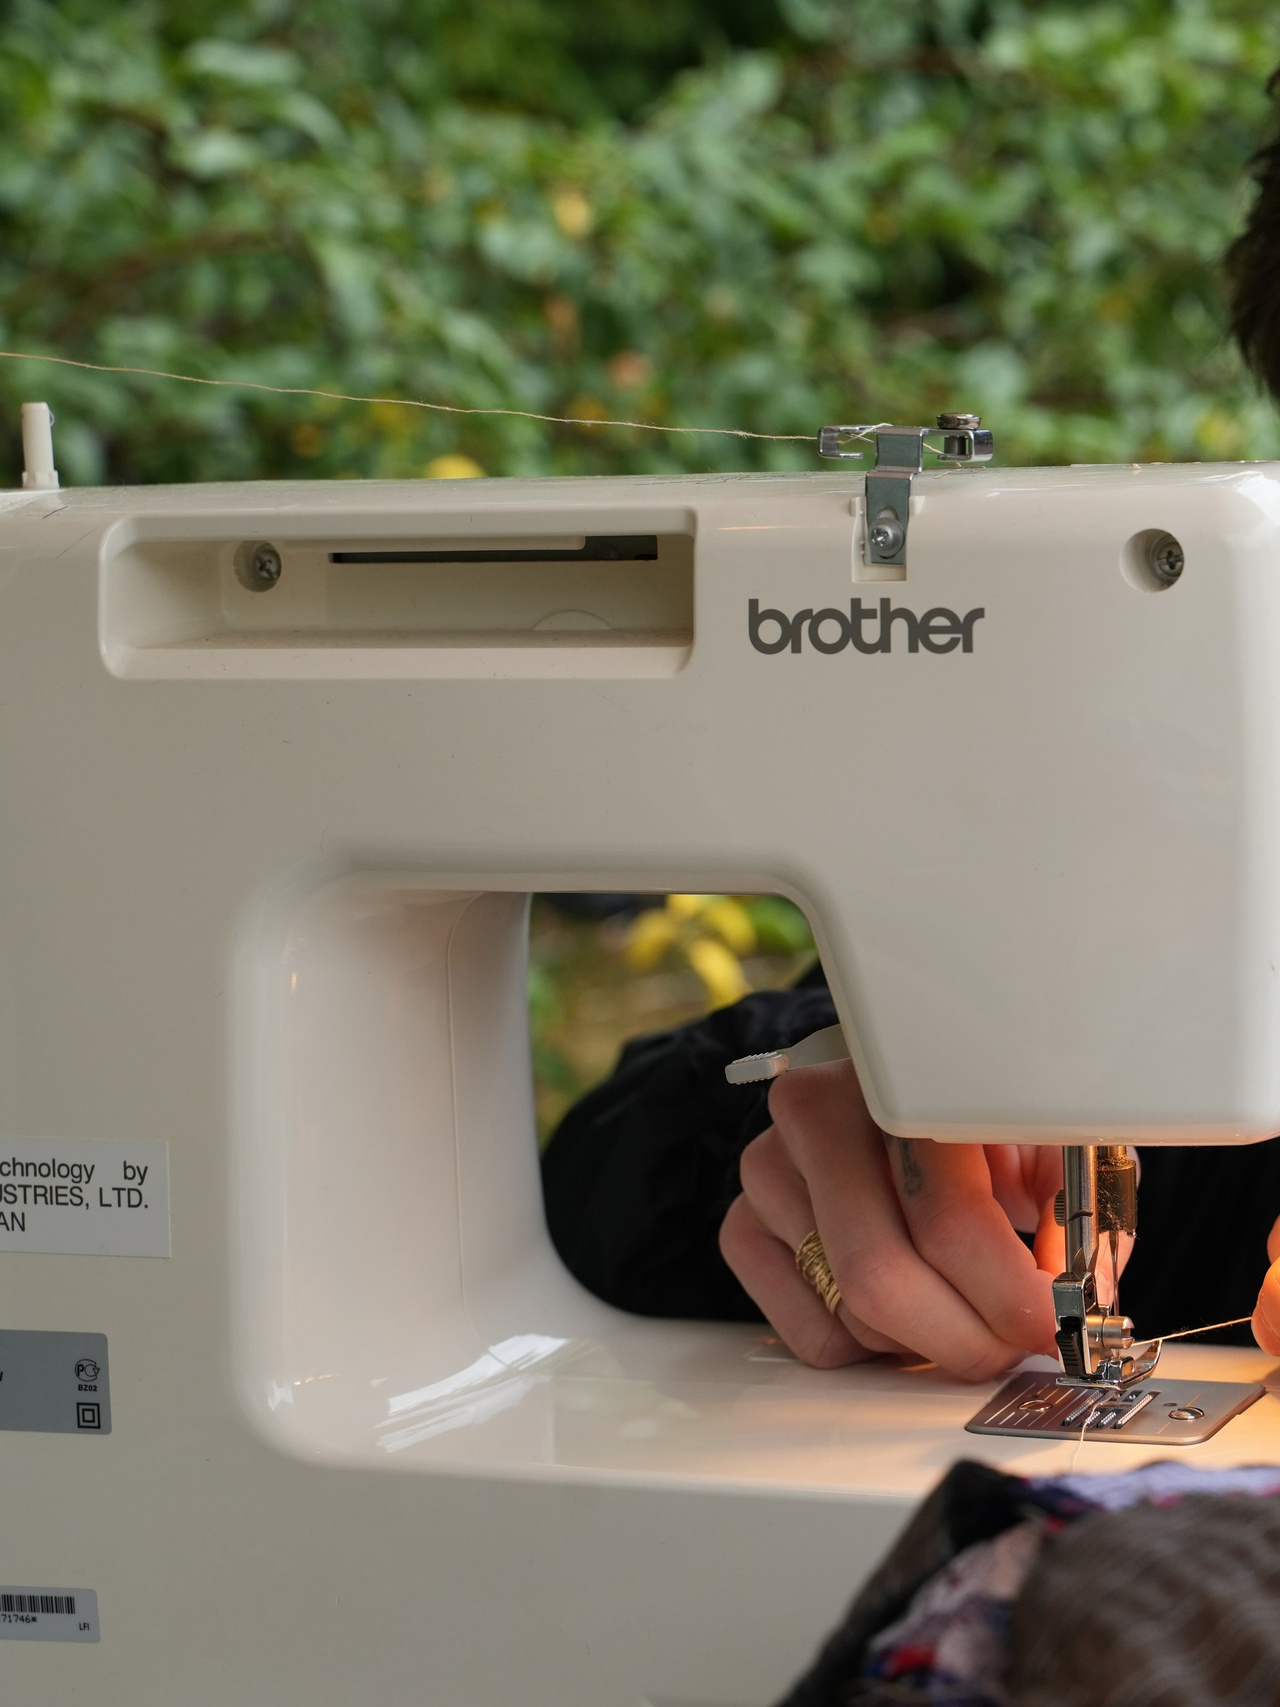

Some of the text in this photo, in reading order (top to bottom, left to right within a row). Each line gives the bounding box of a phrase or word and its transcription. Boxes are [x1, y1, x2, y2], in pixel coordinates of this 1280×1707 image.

[748, 598, 985, 655] brother
[0, 1157, 149, 1186] chnology by
[0, 1183, 149, 1210] STRIES, LTD.
